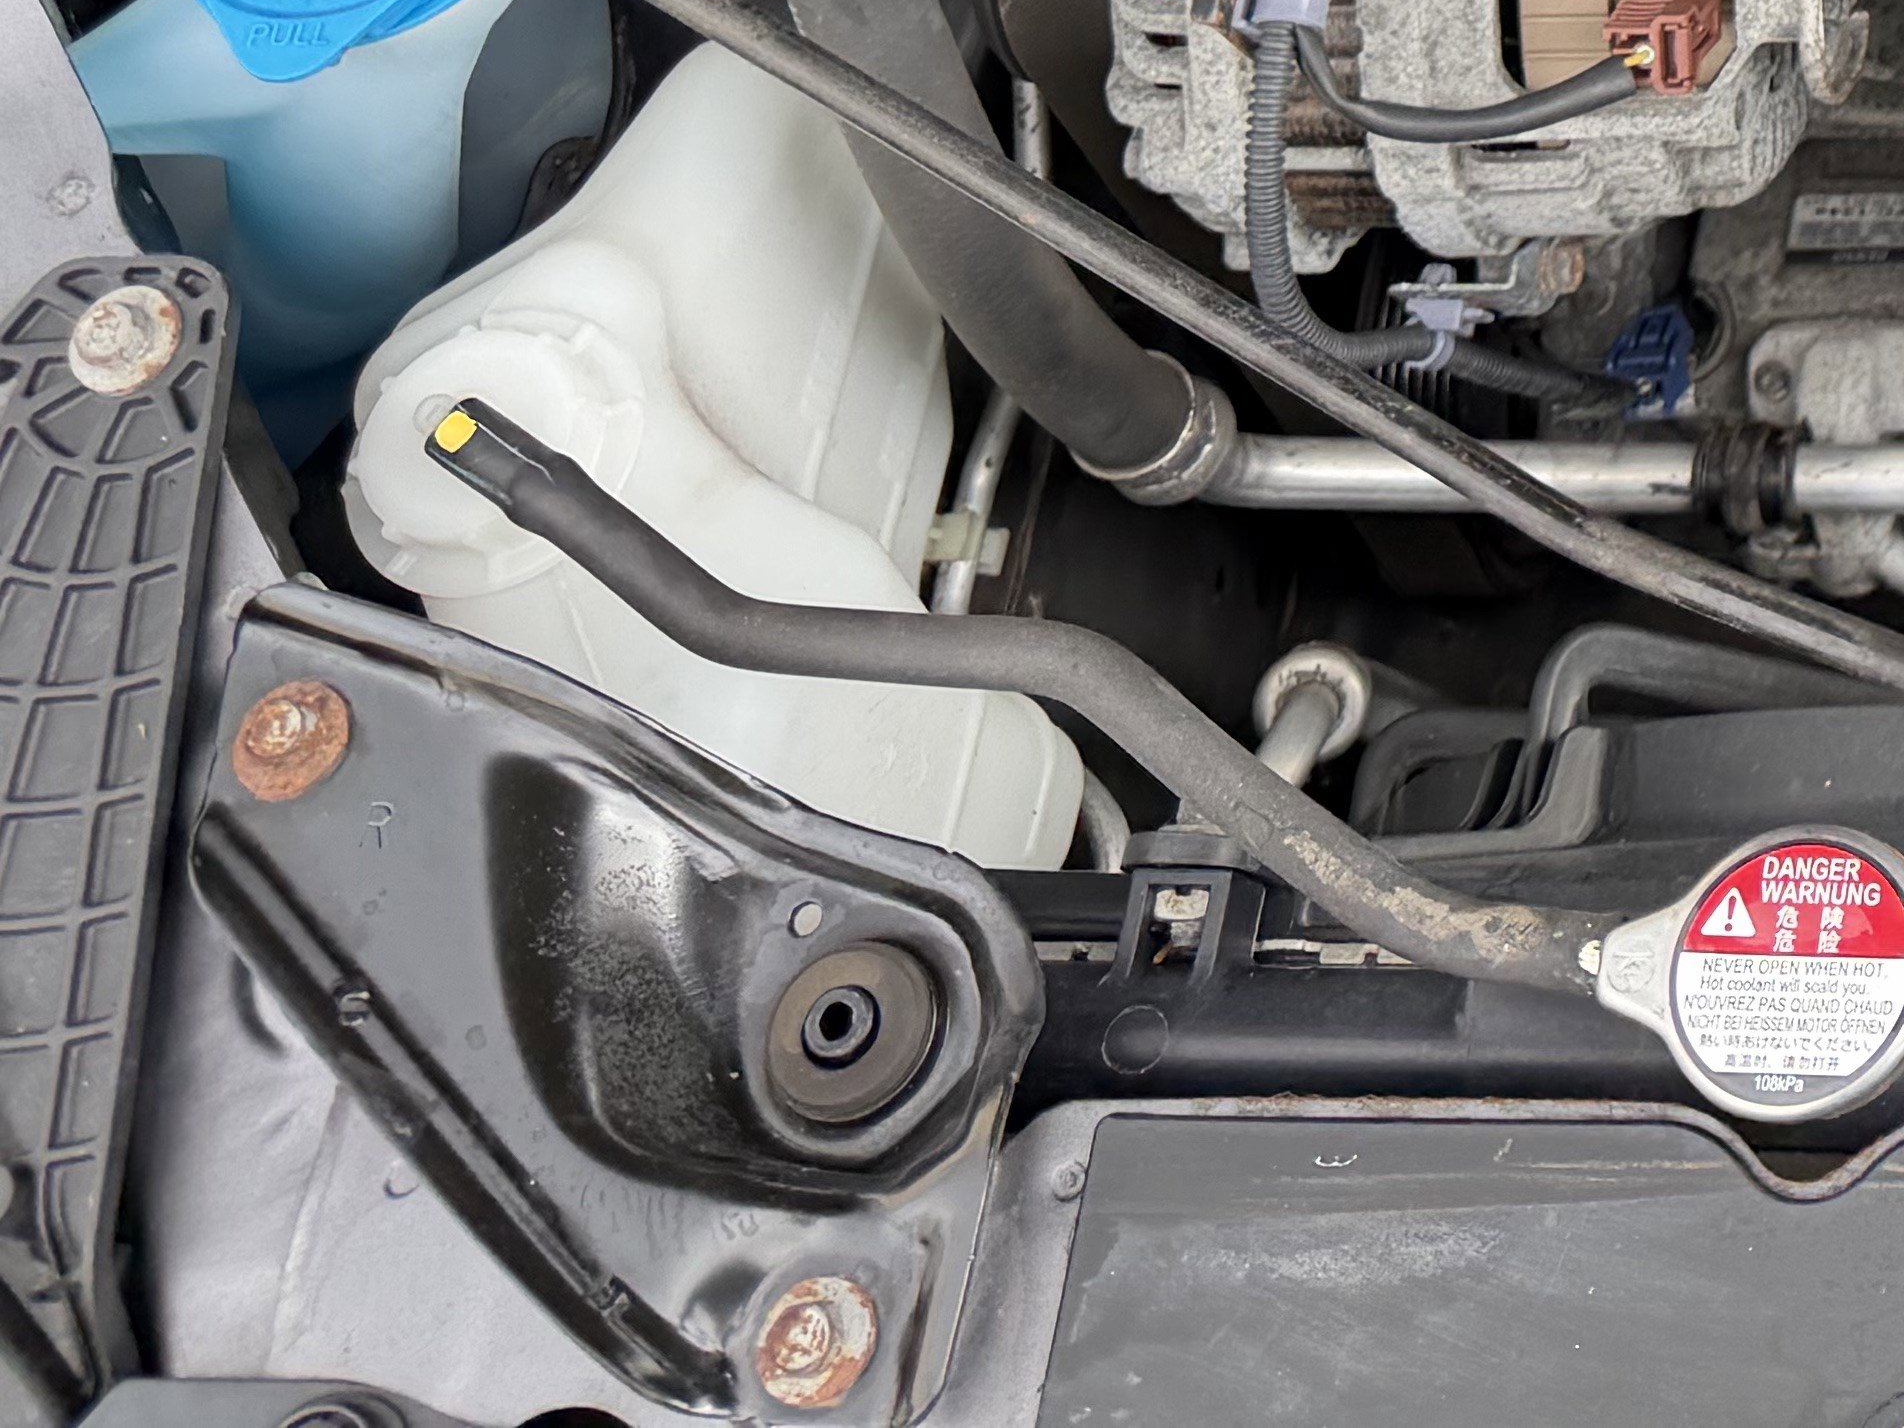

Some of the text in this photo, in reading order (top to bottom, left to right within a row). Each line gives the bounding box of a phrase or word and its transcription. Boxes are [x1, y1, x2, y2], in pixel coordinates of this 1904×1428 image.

[246, 21, 330, 48] PULL
[1762, 855, 1862, 882] DANGER
[1760, 880, 1882, 907] WARNUNG
[1703, 958, 1754, 974] NEVER
[1758, 959, 1801, 976] OPEN
[1805, 961, 1849, 977] WHEN
[1701, 976, 1724, 991] Hot
[1727, 977, 1776, 992] coolant
[1779, 978, 1801, 993] will
[1804, 980, 1839, 995] scald
[1683, 995, 1894, 1016] N'OUVREZ PAS QUAND CHAUD
[1687, 1014, 1721, 1030] NICHT
[1724, 1016, 1743, 1030] BEI
[1744, 1017, 1795, 1032] HEISSEM
[1797, 1018, 1838, 1033] MOTOR
[1754, 1074, 1805, 1093] 108kPa
